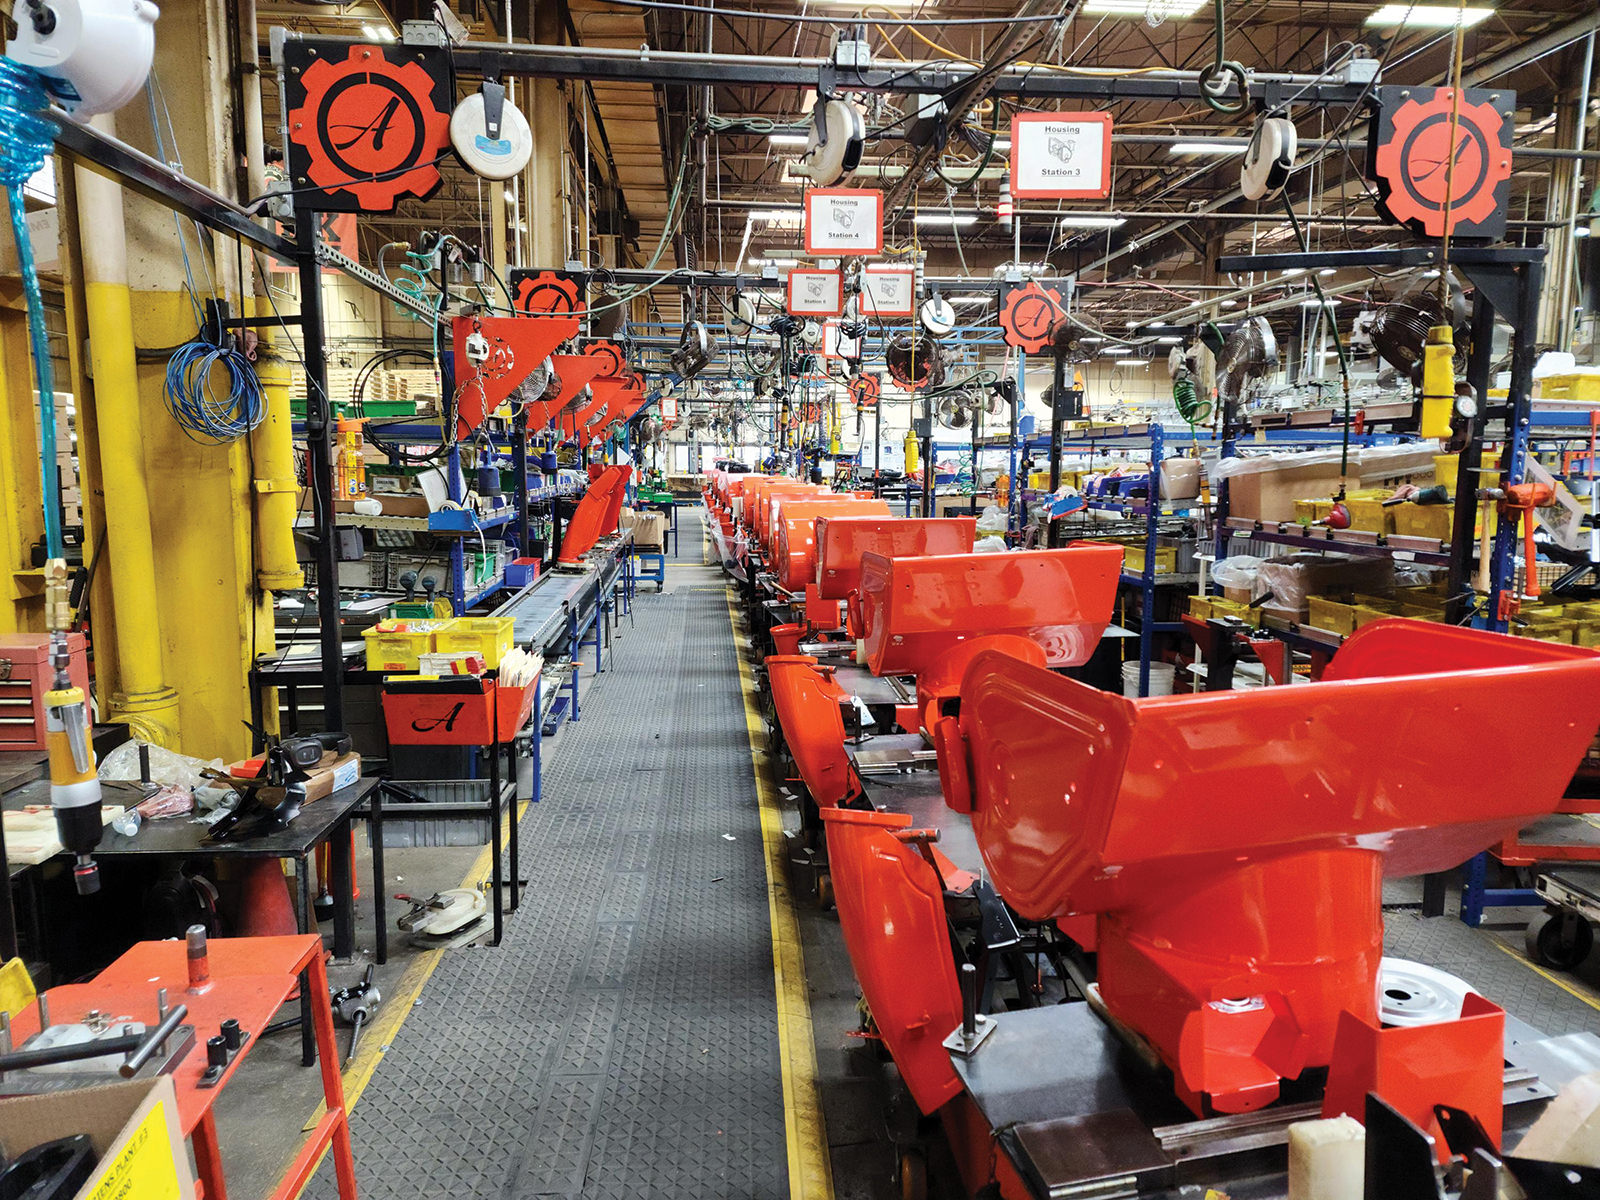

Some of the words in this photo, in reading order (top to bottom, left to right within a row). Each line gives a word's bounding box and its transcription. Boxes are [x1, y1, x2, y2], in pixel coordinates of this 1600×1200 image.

[330, 96, 401, 151] A
[1044, 125, 1080, 134] Housing
[1041, 168, 1073, 176] Station
[411, 702, 466, 732] A
[115, 1142, 137, 1176] PLANT
